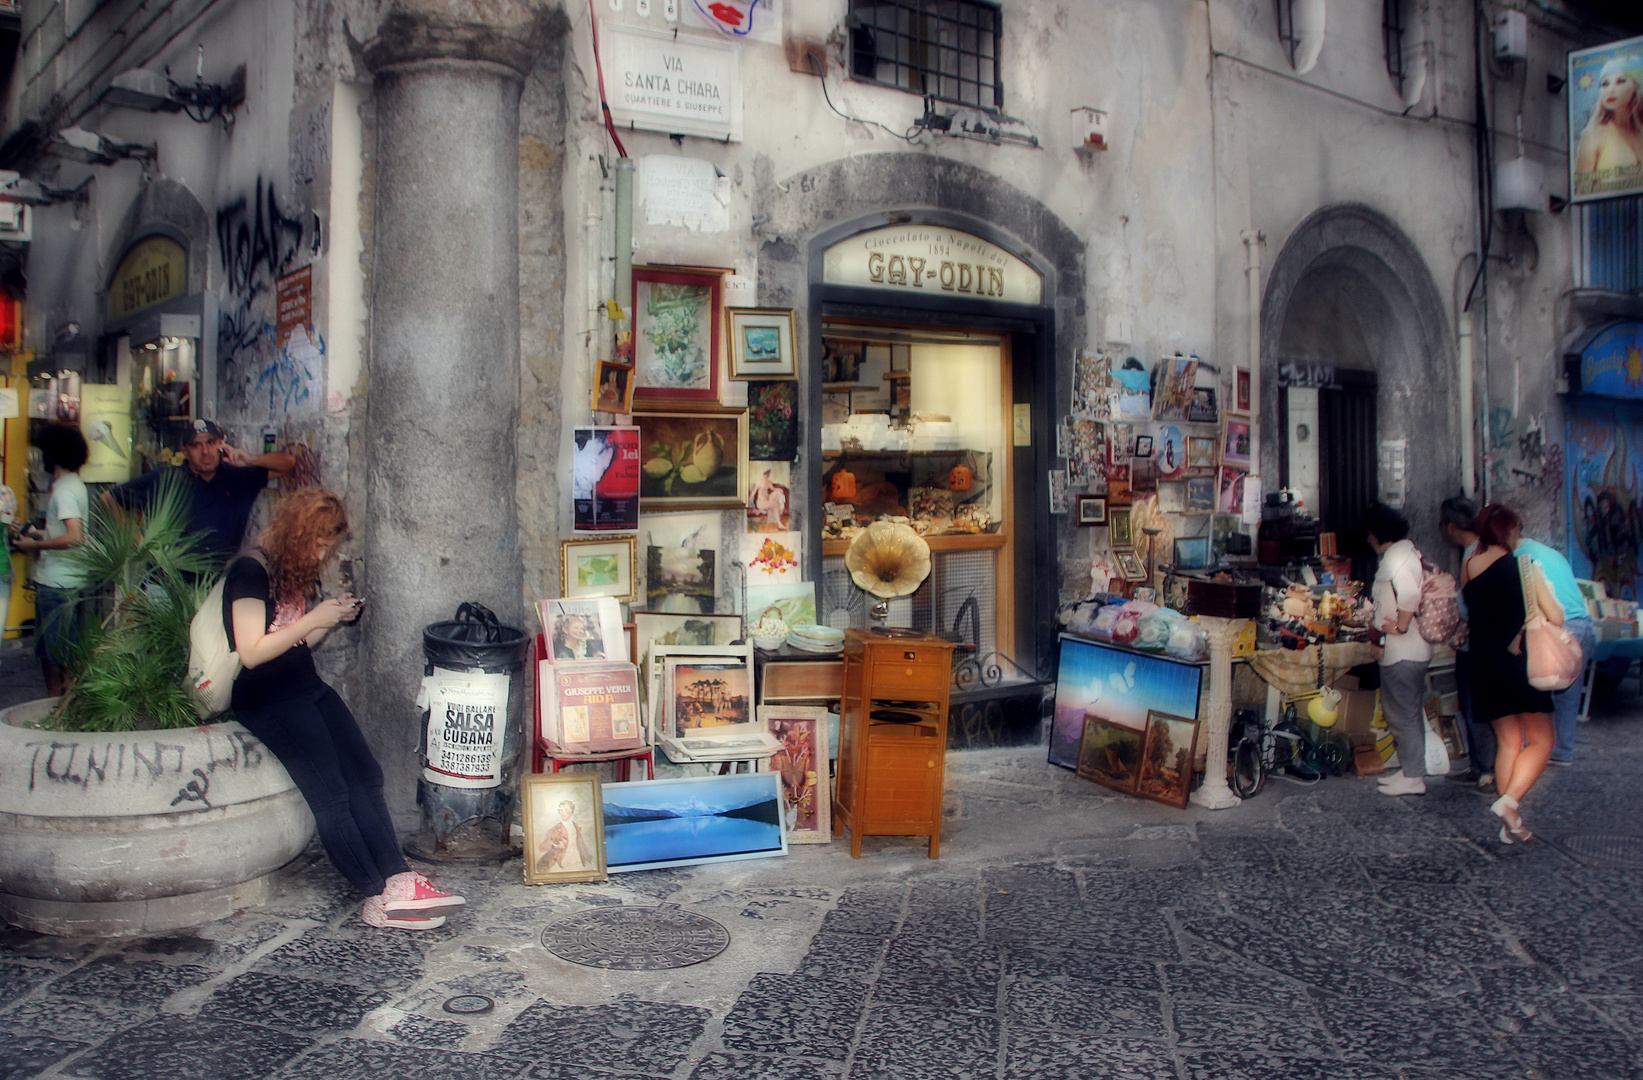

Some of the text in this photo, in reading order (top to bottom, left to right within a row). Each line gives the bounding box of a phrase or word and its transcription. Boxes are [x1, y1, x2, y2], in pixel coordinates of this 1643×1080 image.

[663, 54, 683, 72] VIA
[625, 71, 720, 99] SANTA CHIARA
[625, 93, 671, 108] QUARTIERE
[685, 101, 723, 114] GIUSEPPE
[676, 162, 695, 176] VIA
[864, 232, 930, 250] Cioccolato
[949, 234, 987, 257] Napoli
[928, 243, 951, 256] 1894
[868, 252, 1004, 297] GAY-ODIN
[622, 449, 639, 459] lei
[564, 684, 632, 697] GIUSEPPE VERDI
[583, 694, 615, 704] AIDA
[447, 702, 496, 713] VUOI BALLARE
[445, 709, 494, 731] SALSA
[443, 728, 493, 745] CUBANA
[443, 742, 472, 751] ISCRIZIONI
[441, 749, 491, 764] 3471286139
[440, 759, 490, 773] 3387387933
